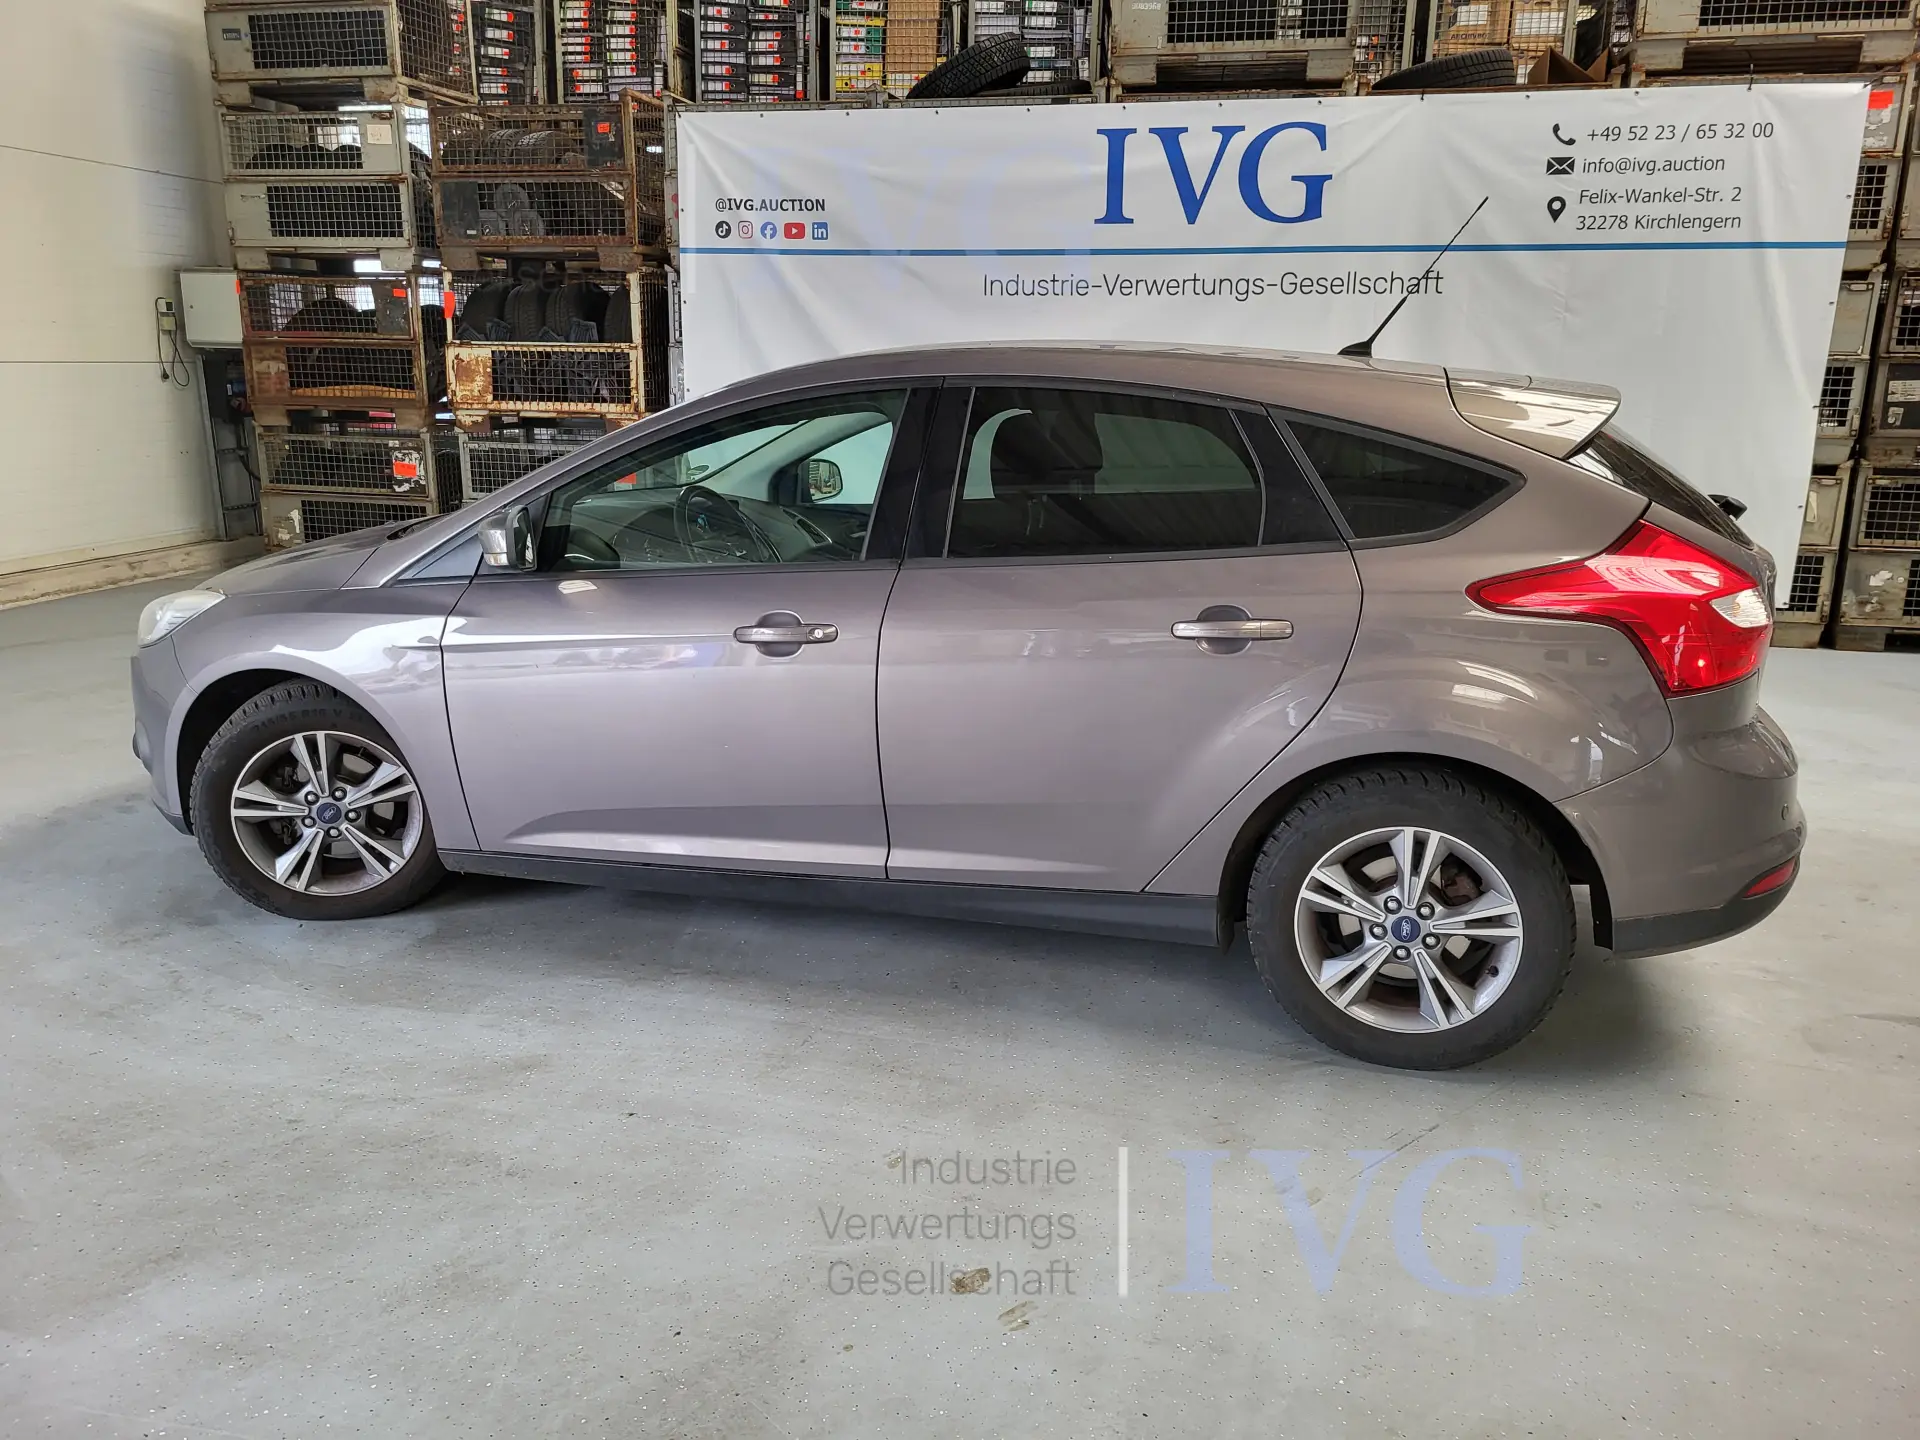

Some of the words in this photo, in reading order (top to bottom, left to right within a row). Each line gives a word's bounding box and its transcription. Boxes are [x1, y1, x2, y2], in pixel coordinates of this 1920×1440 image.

[1586, 125, 1622, 142] +49
[1627, 125, 1649, 142] 52
[1654, 124, 1676, 141] 23
[1680, 123, 1691, 143] /
[1695, 123, 1718, 140] 65
[1723, 122, 1746, 139] 32
[1752, 121, 1774, 139] 00
[1094, 122, 1333, 225] IVG
[1582, 155, 1726, 176] info@ivg.auction
[714, 198, 826, 213] @IVG.AUCTION
[1578, 187, 1724, 205] Felix-Wankel-Str.
[1730, 186, 1742, 202] 2
[1575, 214, 1629, 231] 32278
[1634, 213, 1742, 233] Kirchlengern
[983, 269, 1444, 302] Industrie-Verwertungs-Gesellschaft
